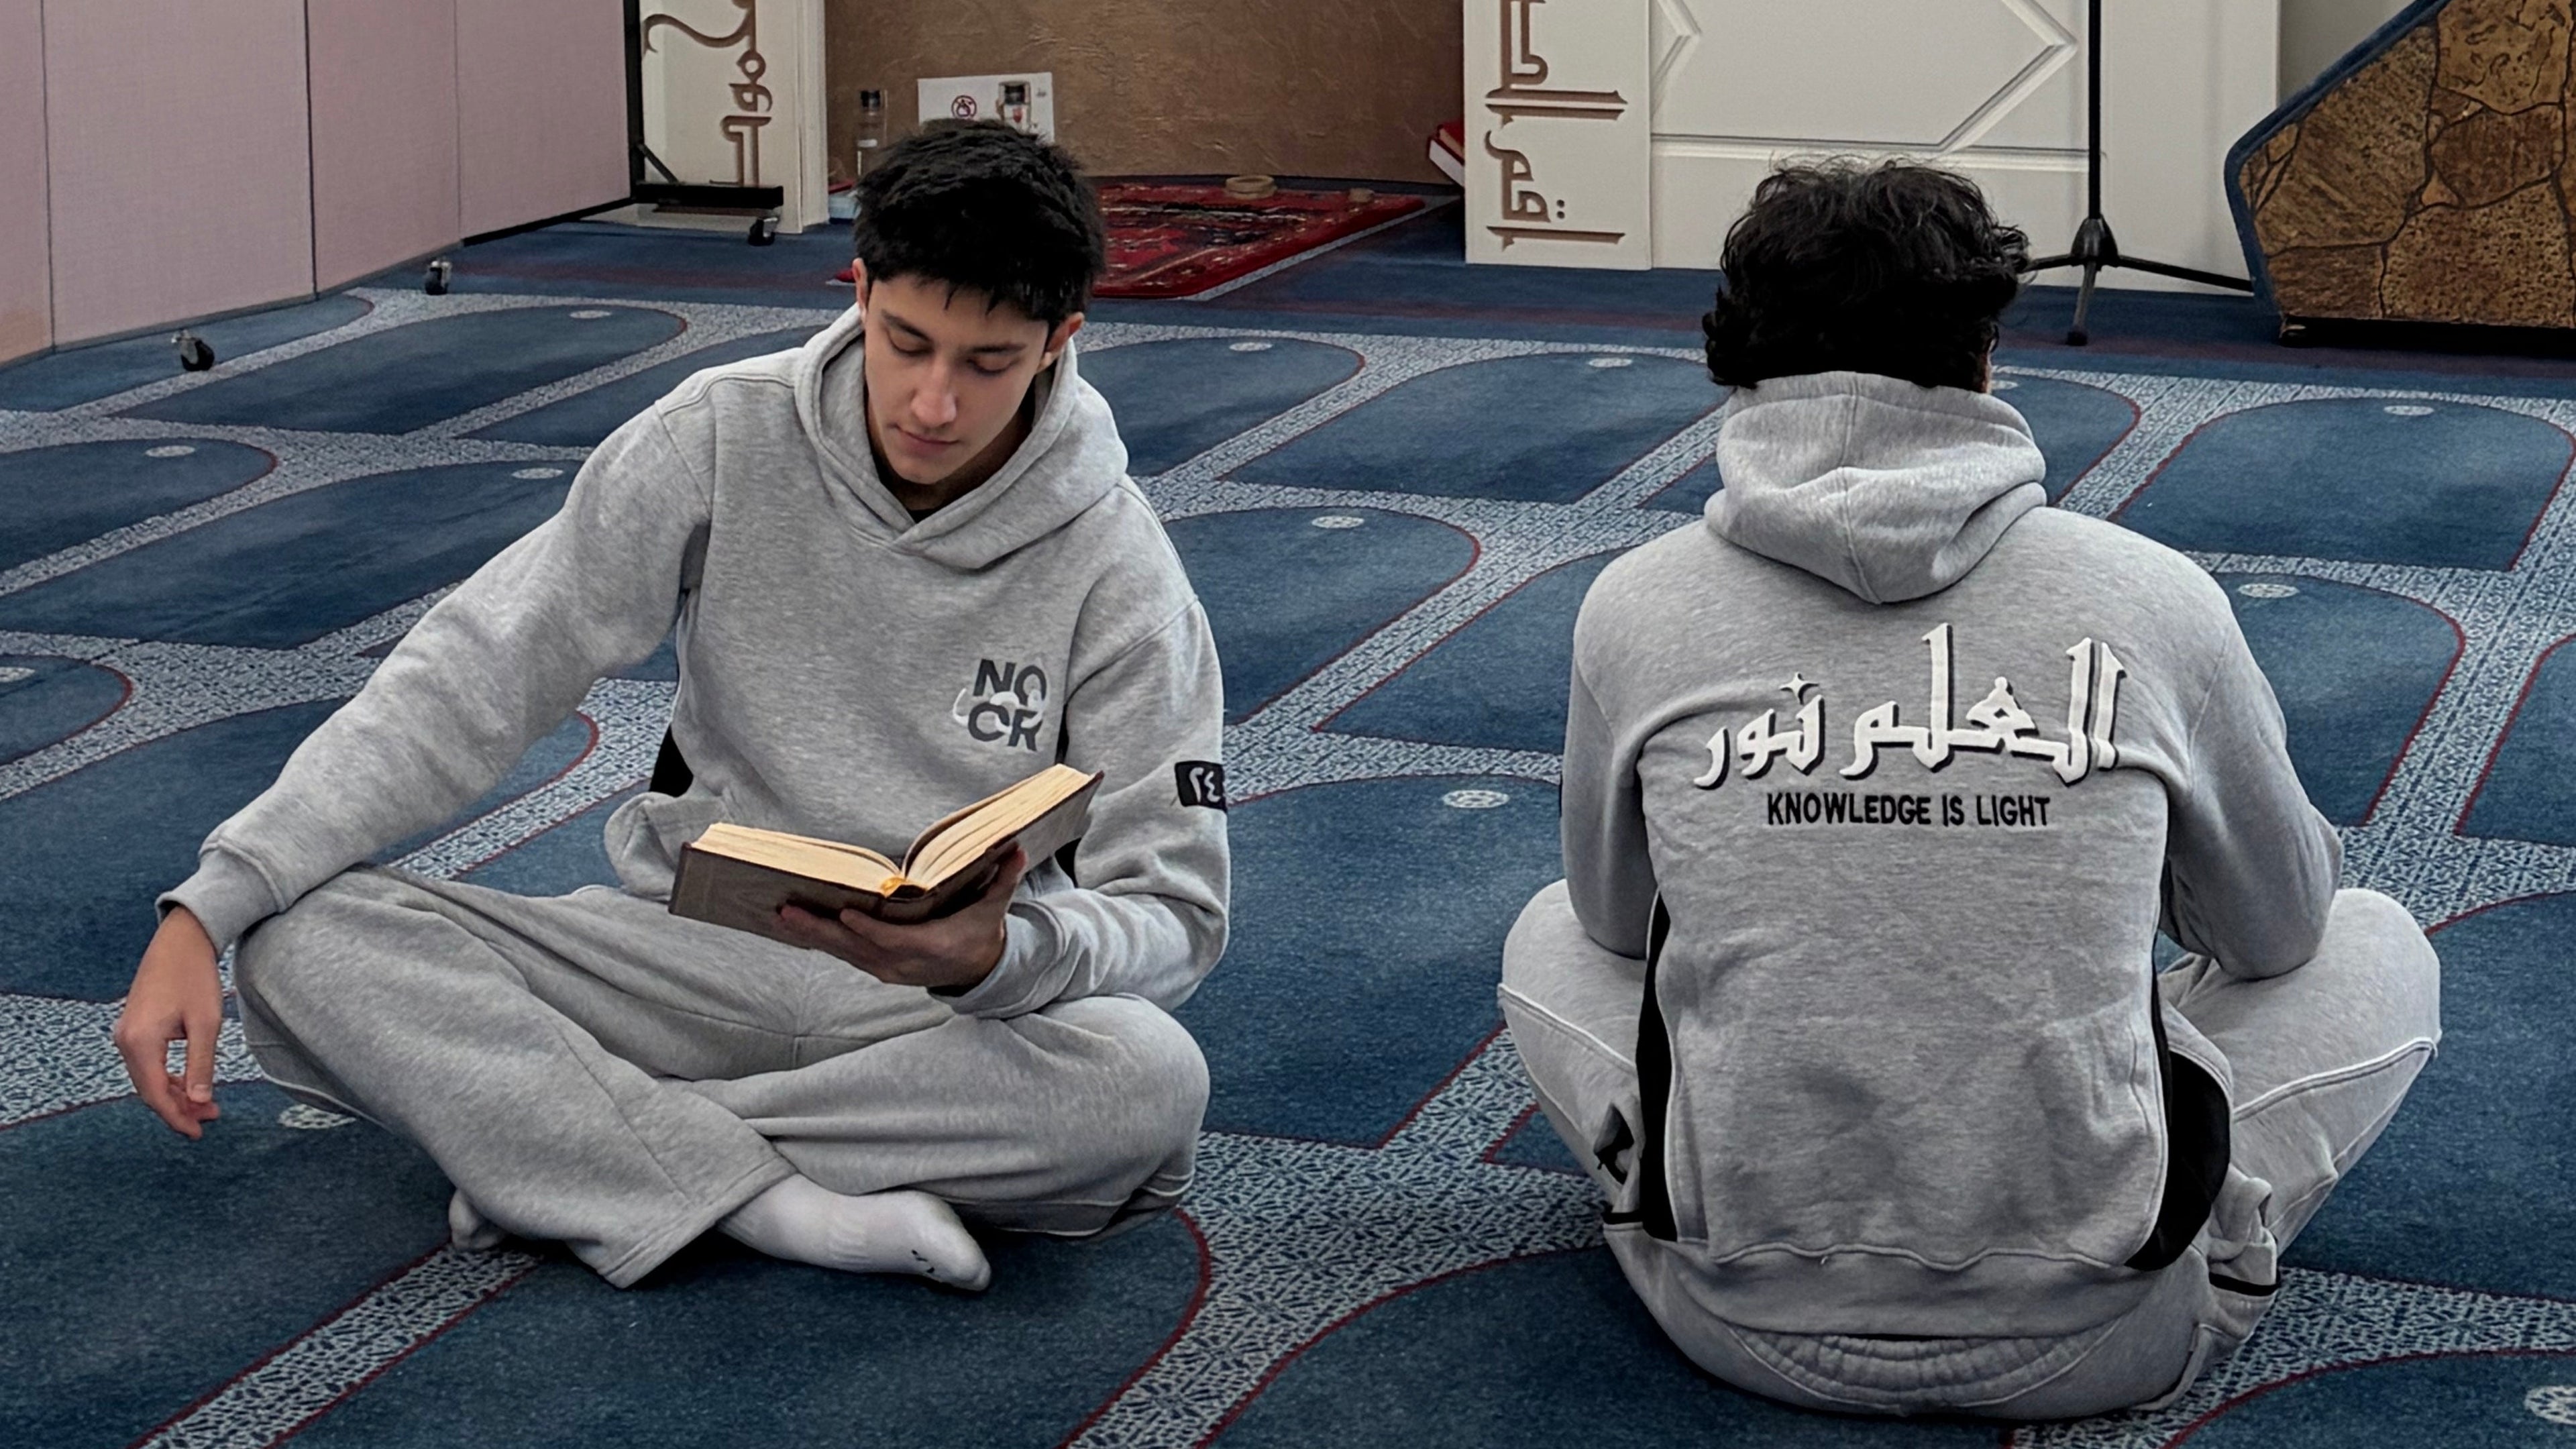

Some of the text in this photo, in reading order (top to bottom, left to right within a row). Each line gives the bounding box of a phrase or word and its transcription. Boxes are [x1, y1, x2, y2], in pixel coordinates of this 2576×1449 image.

[1694, 623, 2127, 790] العلم نور
[1767, 792, 2051, 826] KNOWLEDGE IS LIGHT
